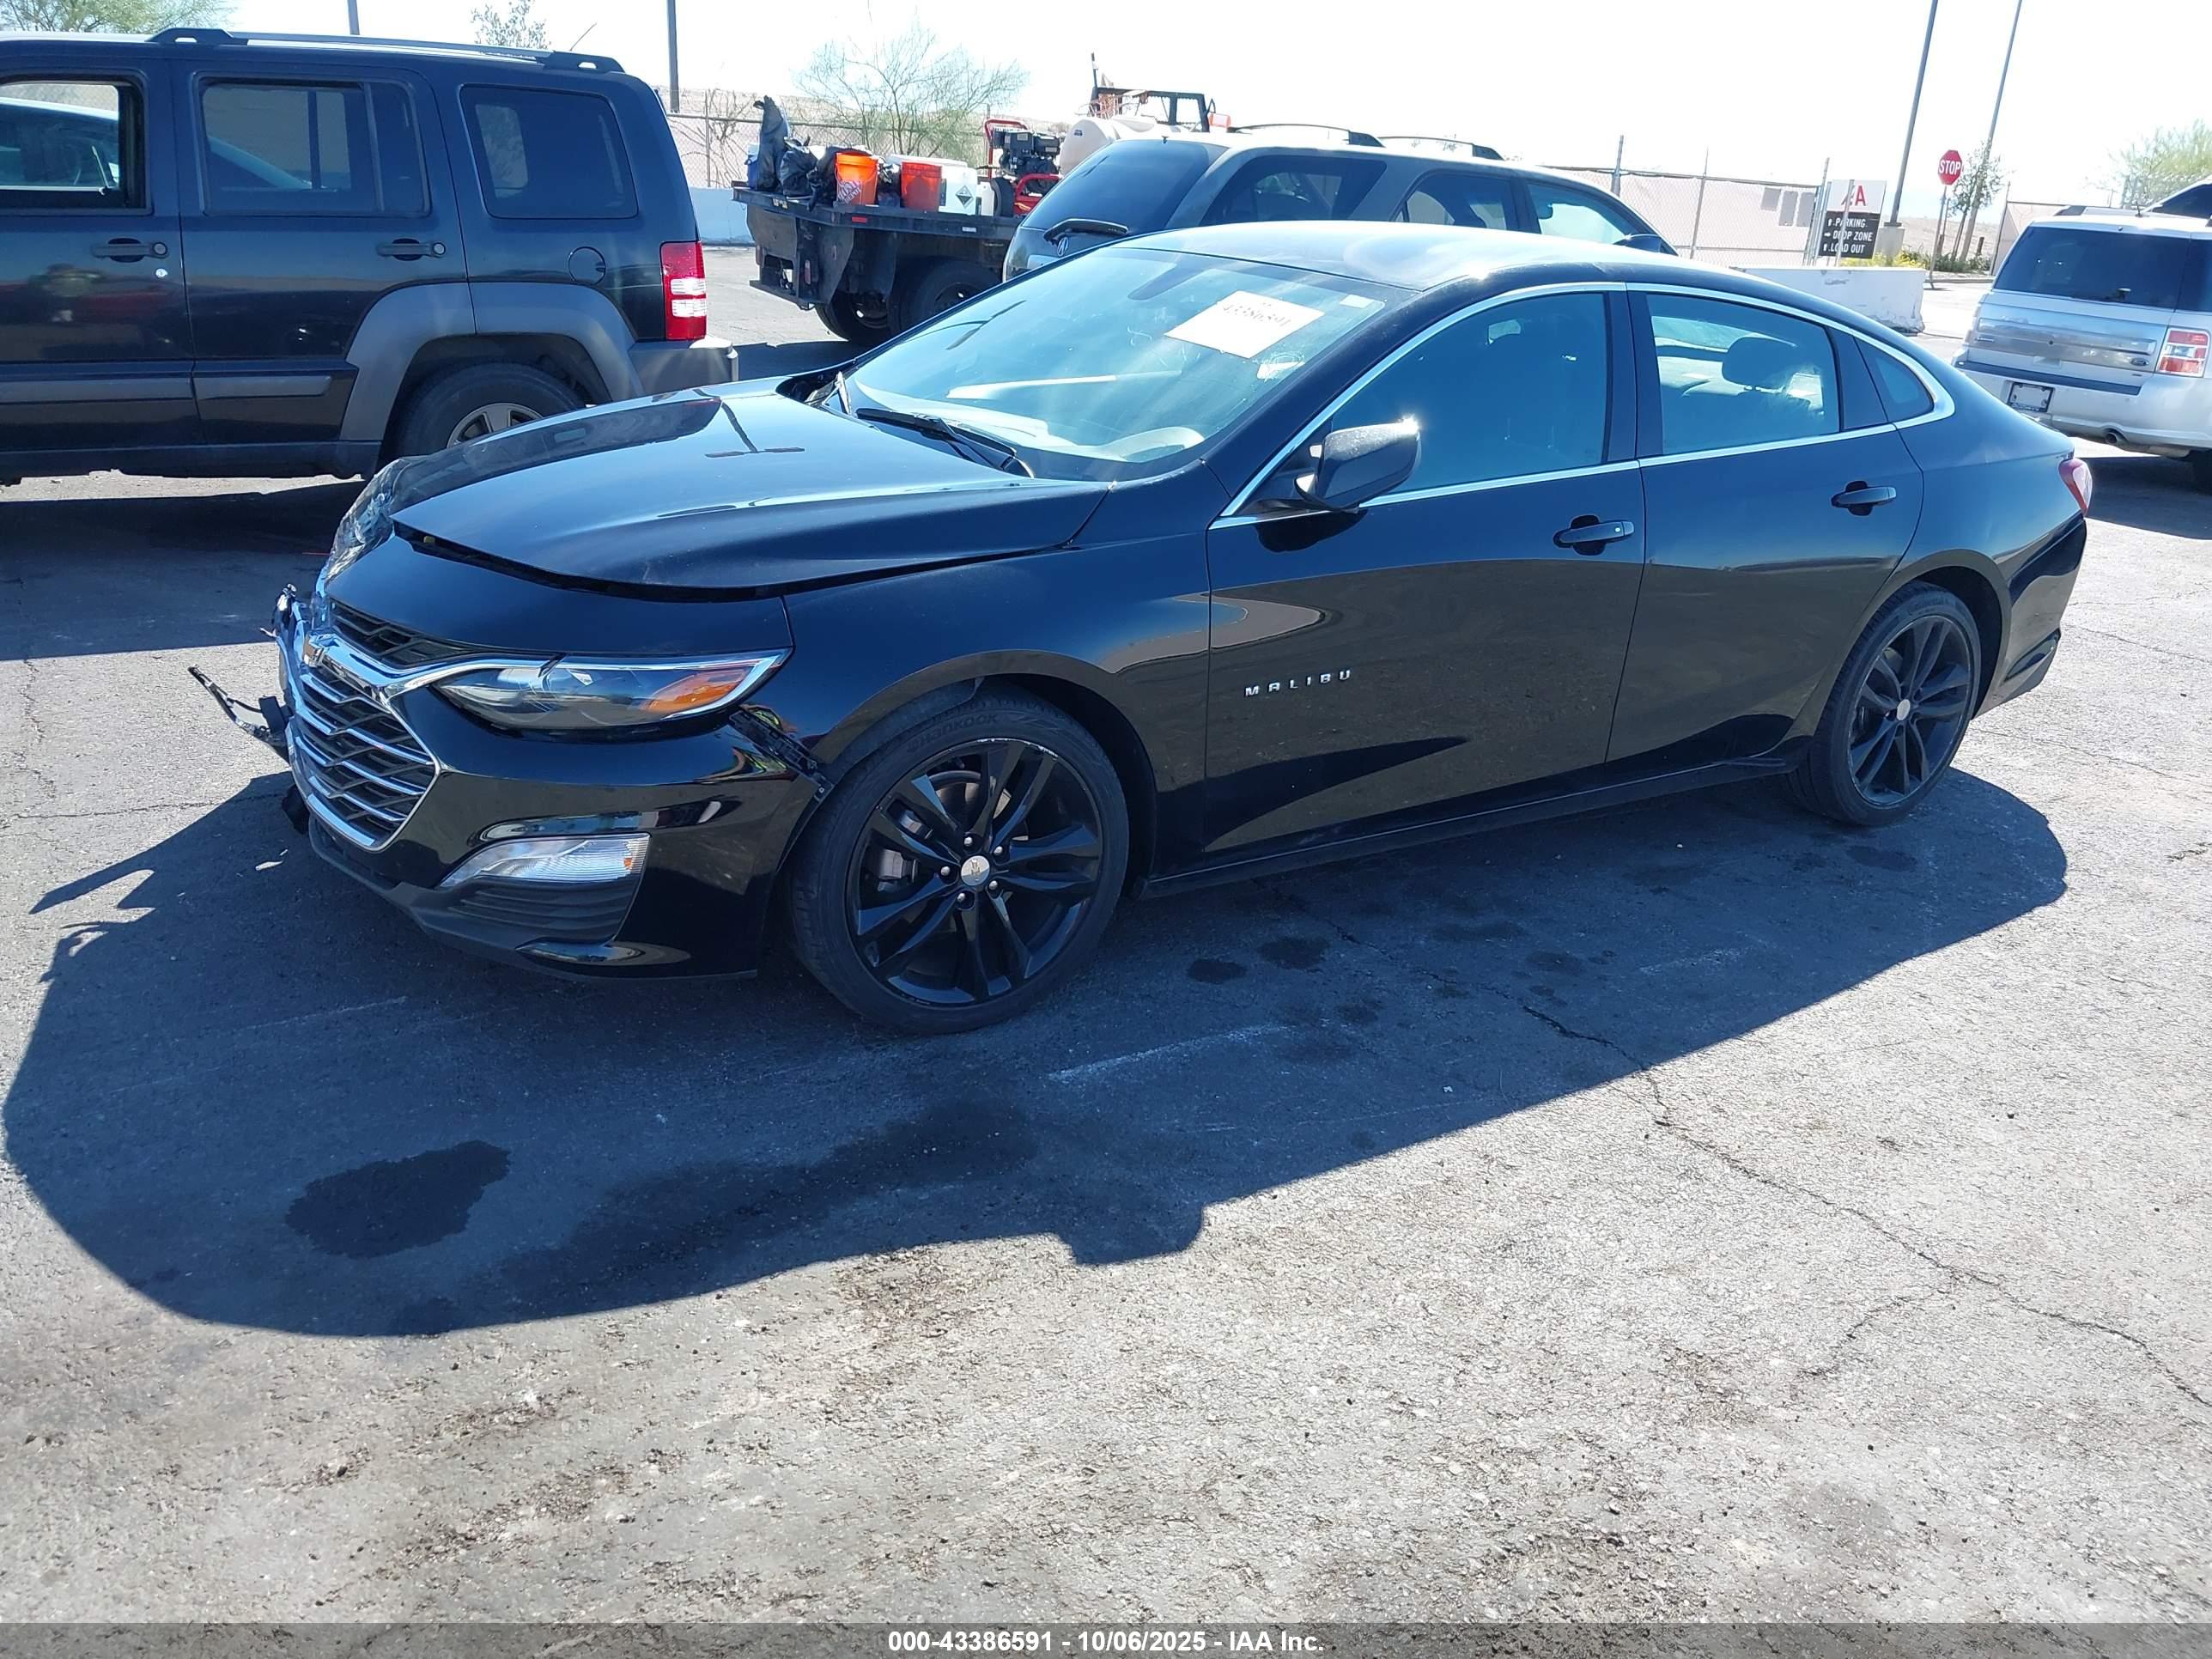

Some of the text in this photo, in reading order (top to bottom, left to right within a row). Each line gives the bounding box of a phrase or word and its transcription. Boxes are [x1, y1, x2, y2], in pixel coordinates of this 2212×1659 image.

[1939, 160, 1961, 175] STOP
[1853, 231, 1874, 242] ZONE
[1850, 244, 1866, 254] OUT
[1244, 669, 1351, 697] MALIBU
